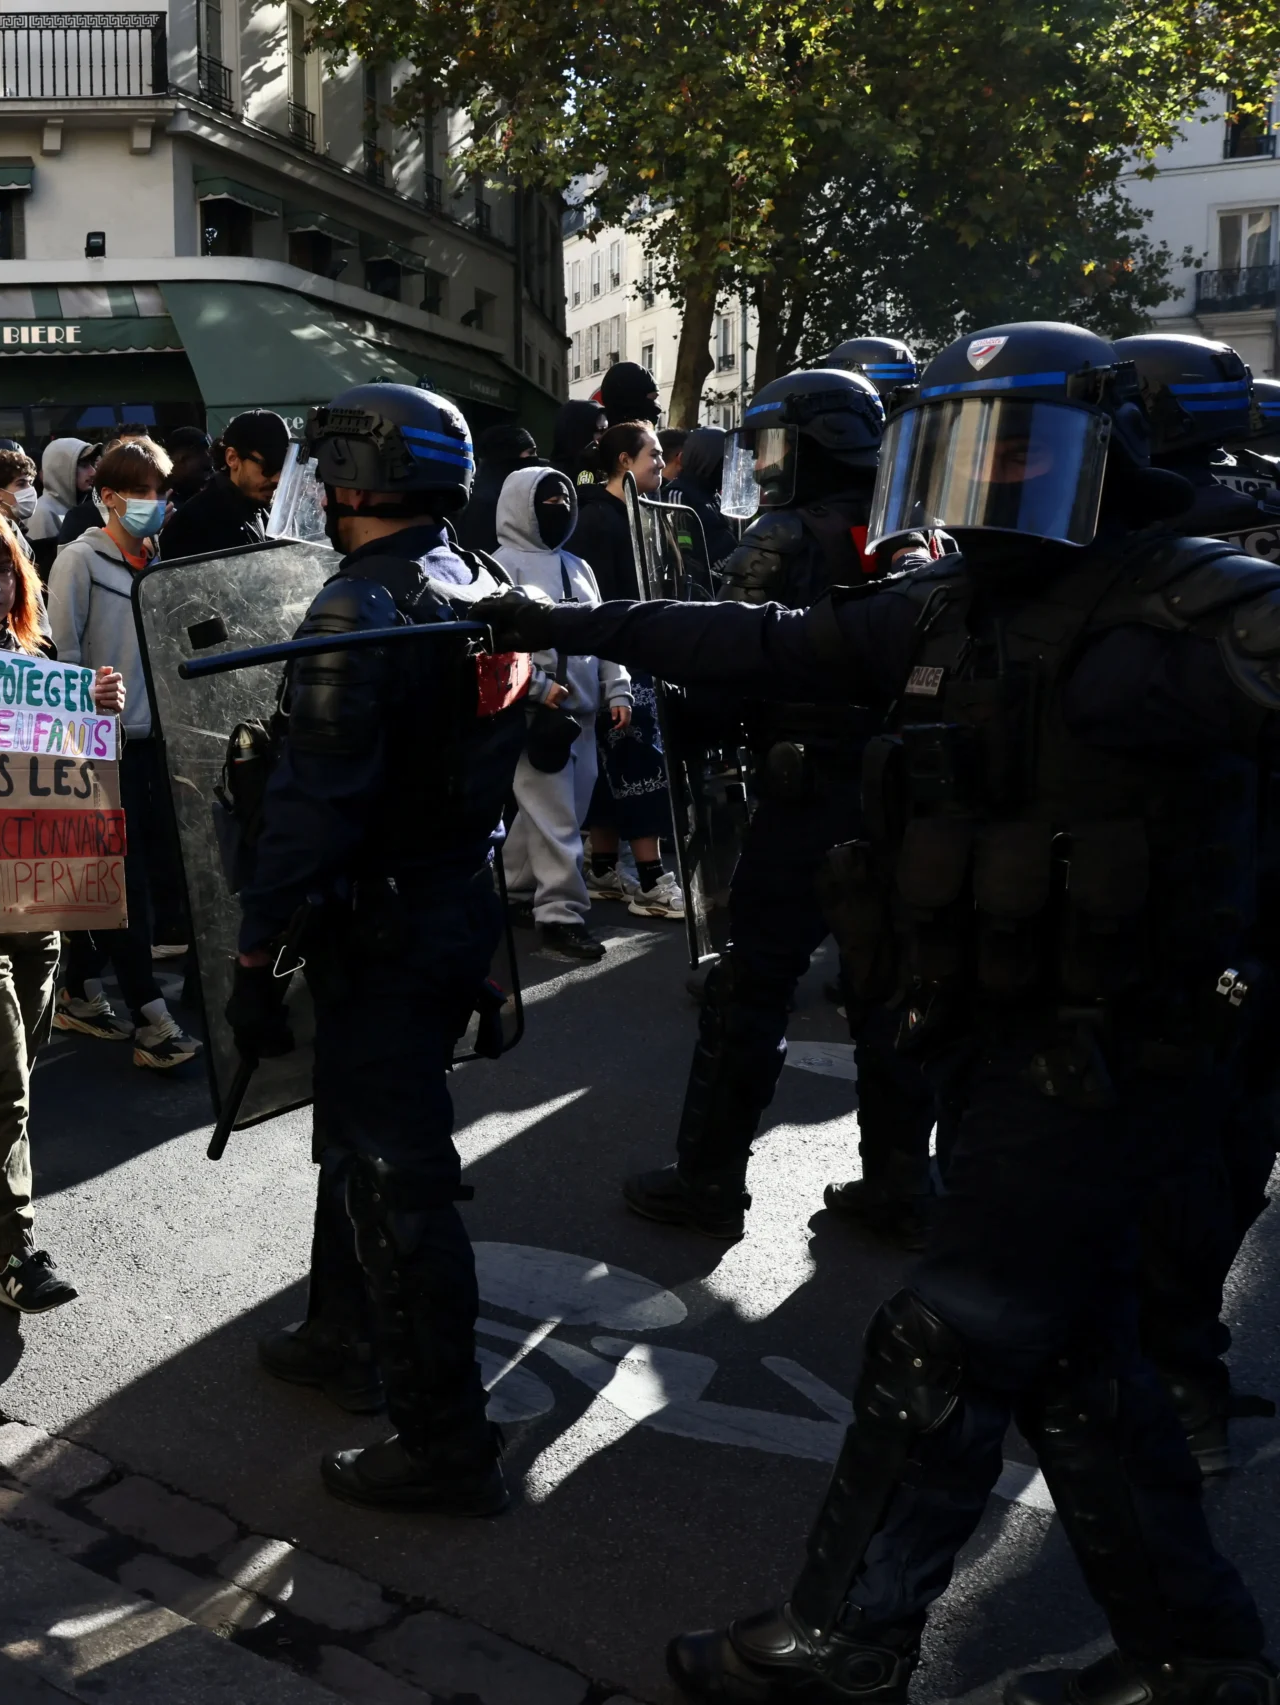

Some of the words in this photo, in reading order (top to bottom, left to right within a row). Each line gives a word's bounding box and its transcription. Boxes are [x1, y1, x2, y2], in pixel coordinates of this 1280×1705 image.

[3, 326, 82, 344] BIERE
[29, 756, 95, 799] LES
[14, 860, 123, 905] PERVERS
